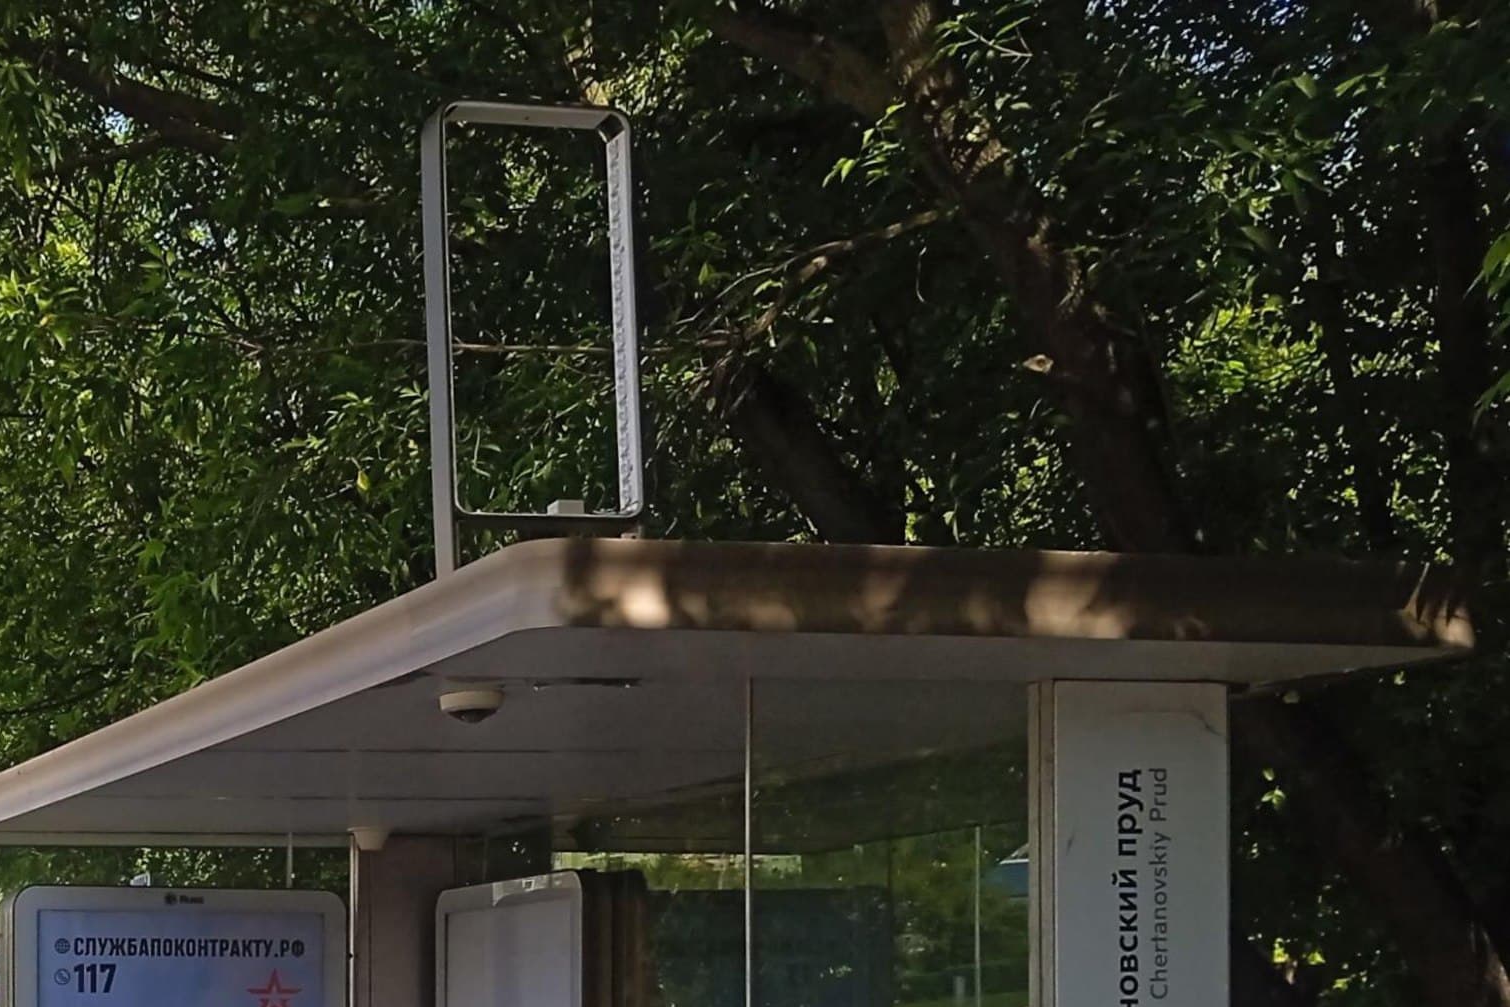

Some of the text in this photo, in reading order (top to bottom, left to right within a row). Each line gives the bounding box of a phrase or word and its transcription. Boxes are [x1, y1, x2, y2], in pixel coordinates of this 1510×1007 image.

[1117, 768, 1143, 856] пруд
[1148, 767, 1168, 822] Prud
[1148, 831, 1171, 1000] Chertanovskiy
[74, 937, 305, 958] СЛУЖБАПОКОНТРАКТУ.РФ
[73, 963, 117, 993] 117
